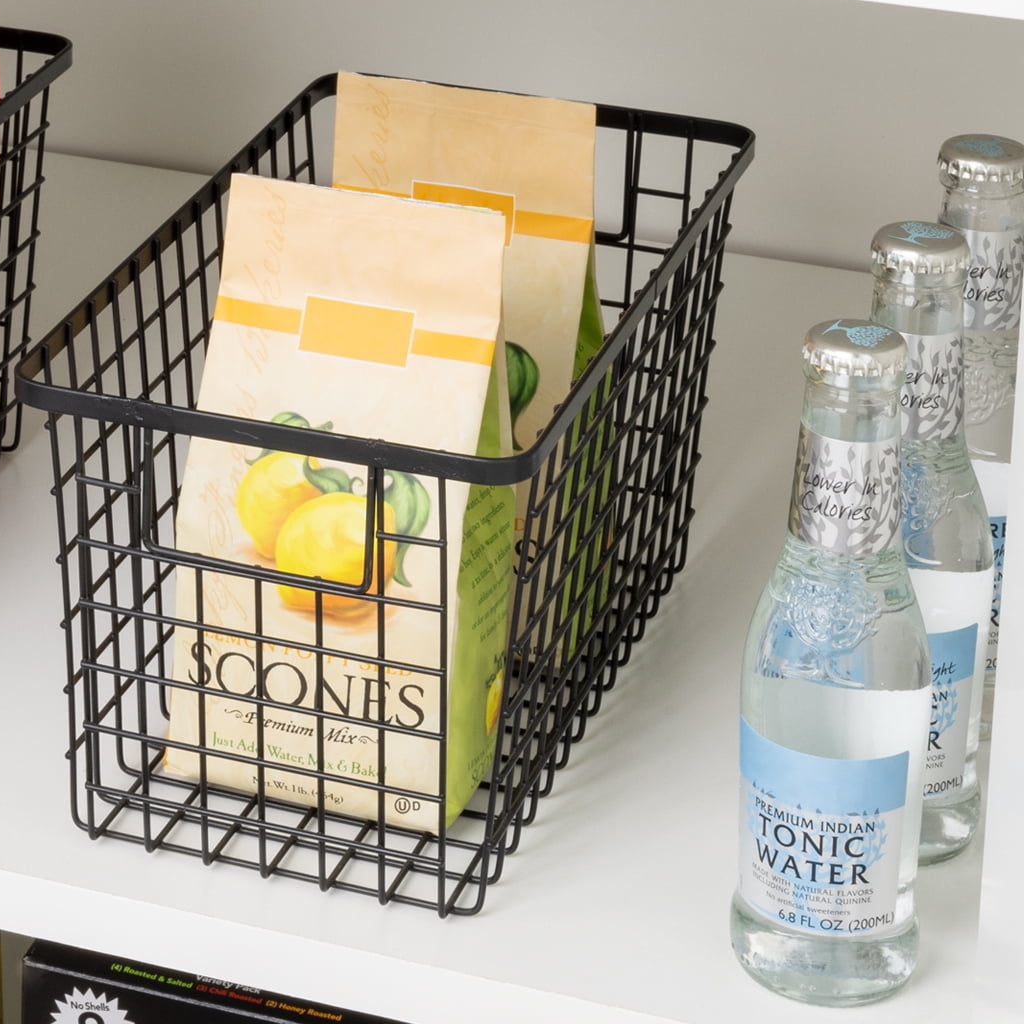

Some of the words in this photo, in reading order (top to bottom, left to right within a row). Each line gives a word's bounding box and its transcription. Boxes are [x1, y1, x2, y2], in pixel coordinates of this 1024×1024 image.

[804, 464, 856, 494] Lower
[862, 476, 880, 496] In
[802, 490, 873, 521] Calories
[188, 640, 426, 729] SCONES
[242, 712, 314, 738] Pemium
[324, 726, 358, 745] Mix
[212, 732, 234, 748] Just
[266, 744, 305, 766] Water,
[337, 760, 348, 772] &
[755, 796, 814, 830] PREMIUM
[820, 821, 876, 834] INDIAN
[758, 812, 866, 858] TONIC
[756, 838, 871, 886] WATER
[752, 862, 770, 878] MADE
[771, 875, 792, 888] WITH
[793, 882, 834, 897] NATURAL
[836, 888, 874, 898] FLAVORS
[752, 871, 790, 896] INCLUDING
[792, 890, 832, 905] NATURAL
[835, 896, 872, 906] QUININE
[766, 890, 776, 901] No
[777, 896, 804, 911] artificial
[807, 906, 851, 916] sweeteners
[778, 908, 796, 924] 6.8
[800, 915, 816, 928] FL
[820, 918, 844, 932] OZ
[848, 912, 895, 934] (200ML)
[110, 962, 123, 972] (4)
[123, 966, 158, 980] Roasted
[166, 978, 194, 989] Salted
[196, 974, 234, 990] Variety
[235, 982, 261, 994] Pack
[70, 1000, 84, 1010] No
[85, 1002, 111, 1012] Shells
[228, 990, 264, 1004] Roasted
[265, 1000, 278, 1008] (2)
[278, 1002, 307, 1016] Honey
[307, 1008, 343, 1022] Roasted
